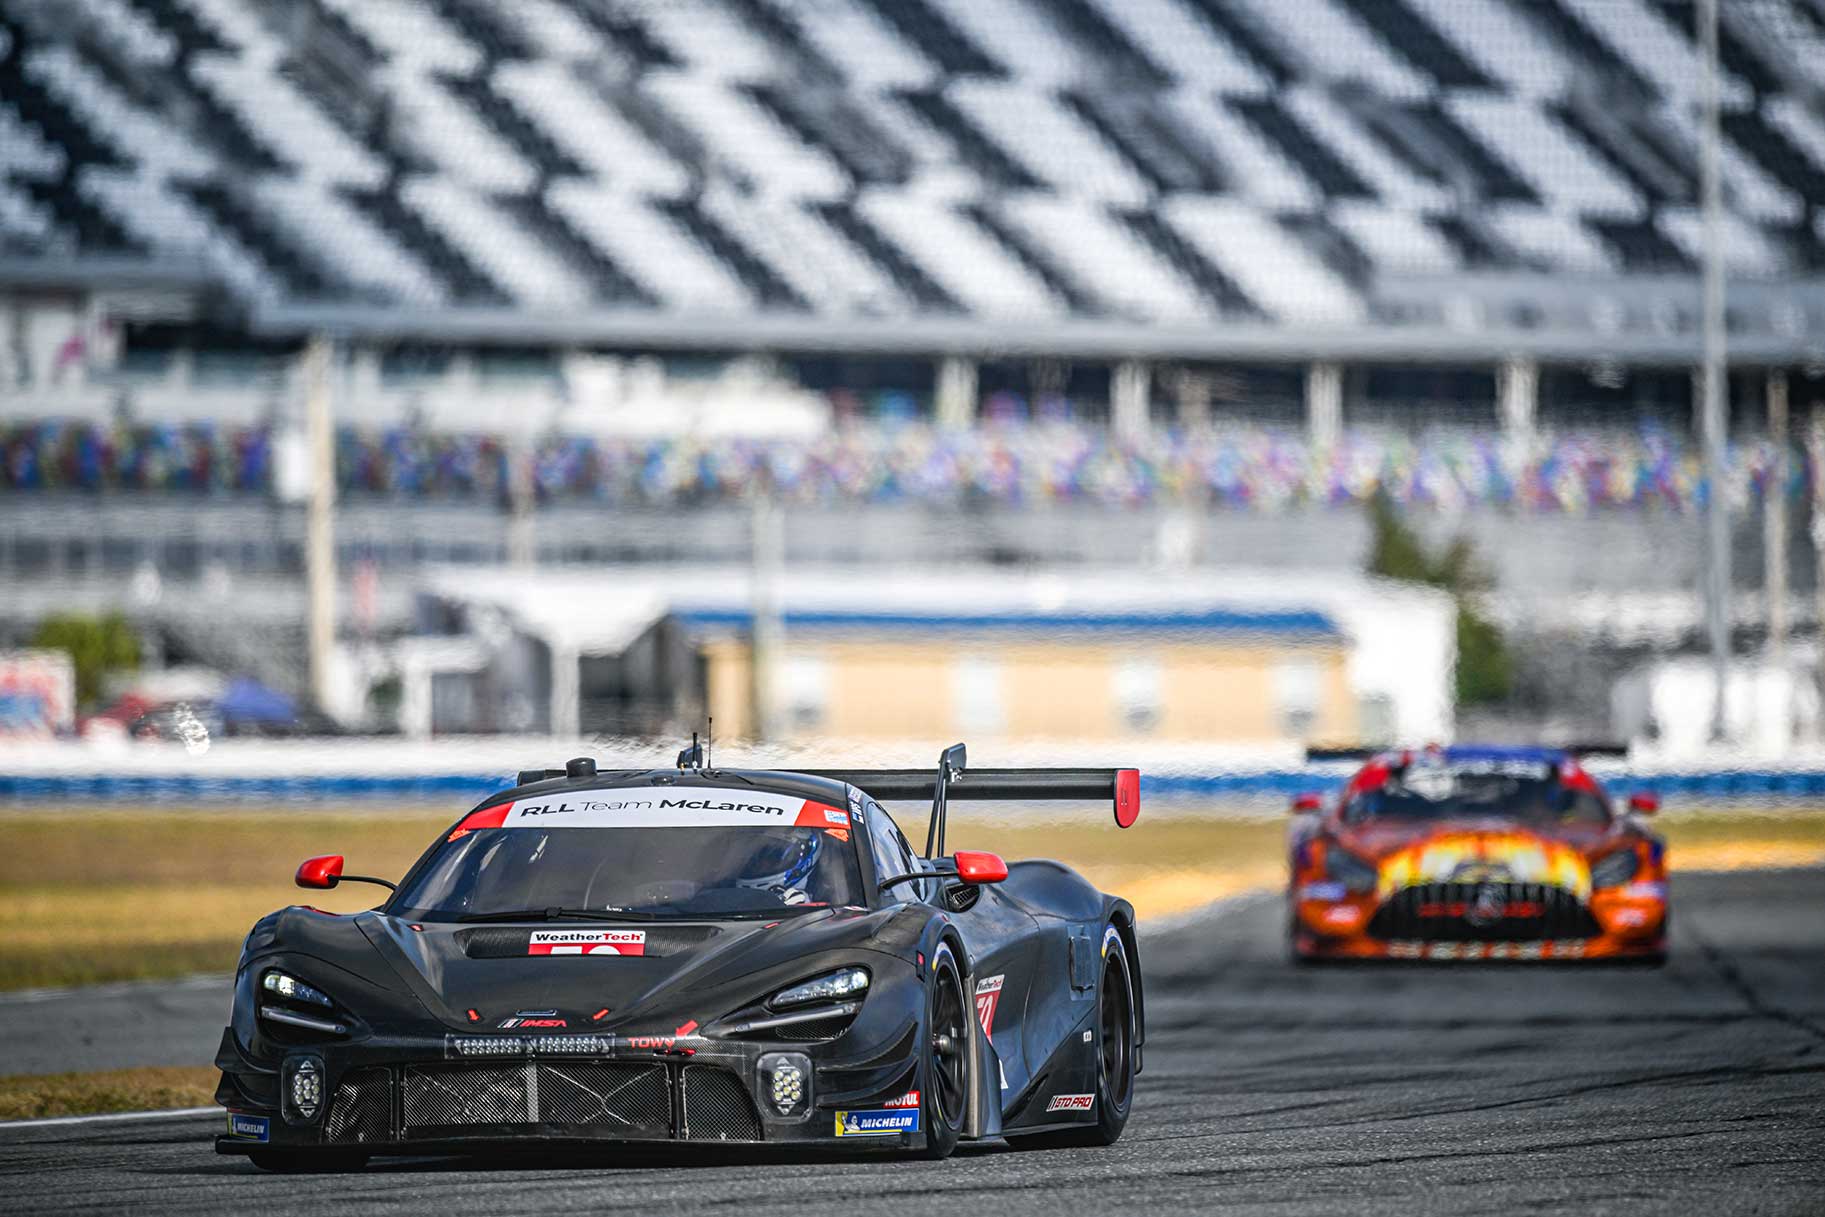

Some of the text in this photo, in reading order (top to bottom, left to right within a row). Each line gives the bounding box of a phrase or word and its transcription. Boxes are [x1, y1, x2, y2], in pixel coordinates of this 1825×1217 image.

[520, 799, 785, 817] RLL Team McLaren
[535, 932, 641, 942] WeatherTech
[520, 1019, 567, 1028] IMSA
[1072, 1097, 1091, 1108] PRO
[861, 1117, 912, 1128] MICHELIN
